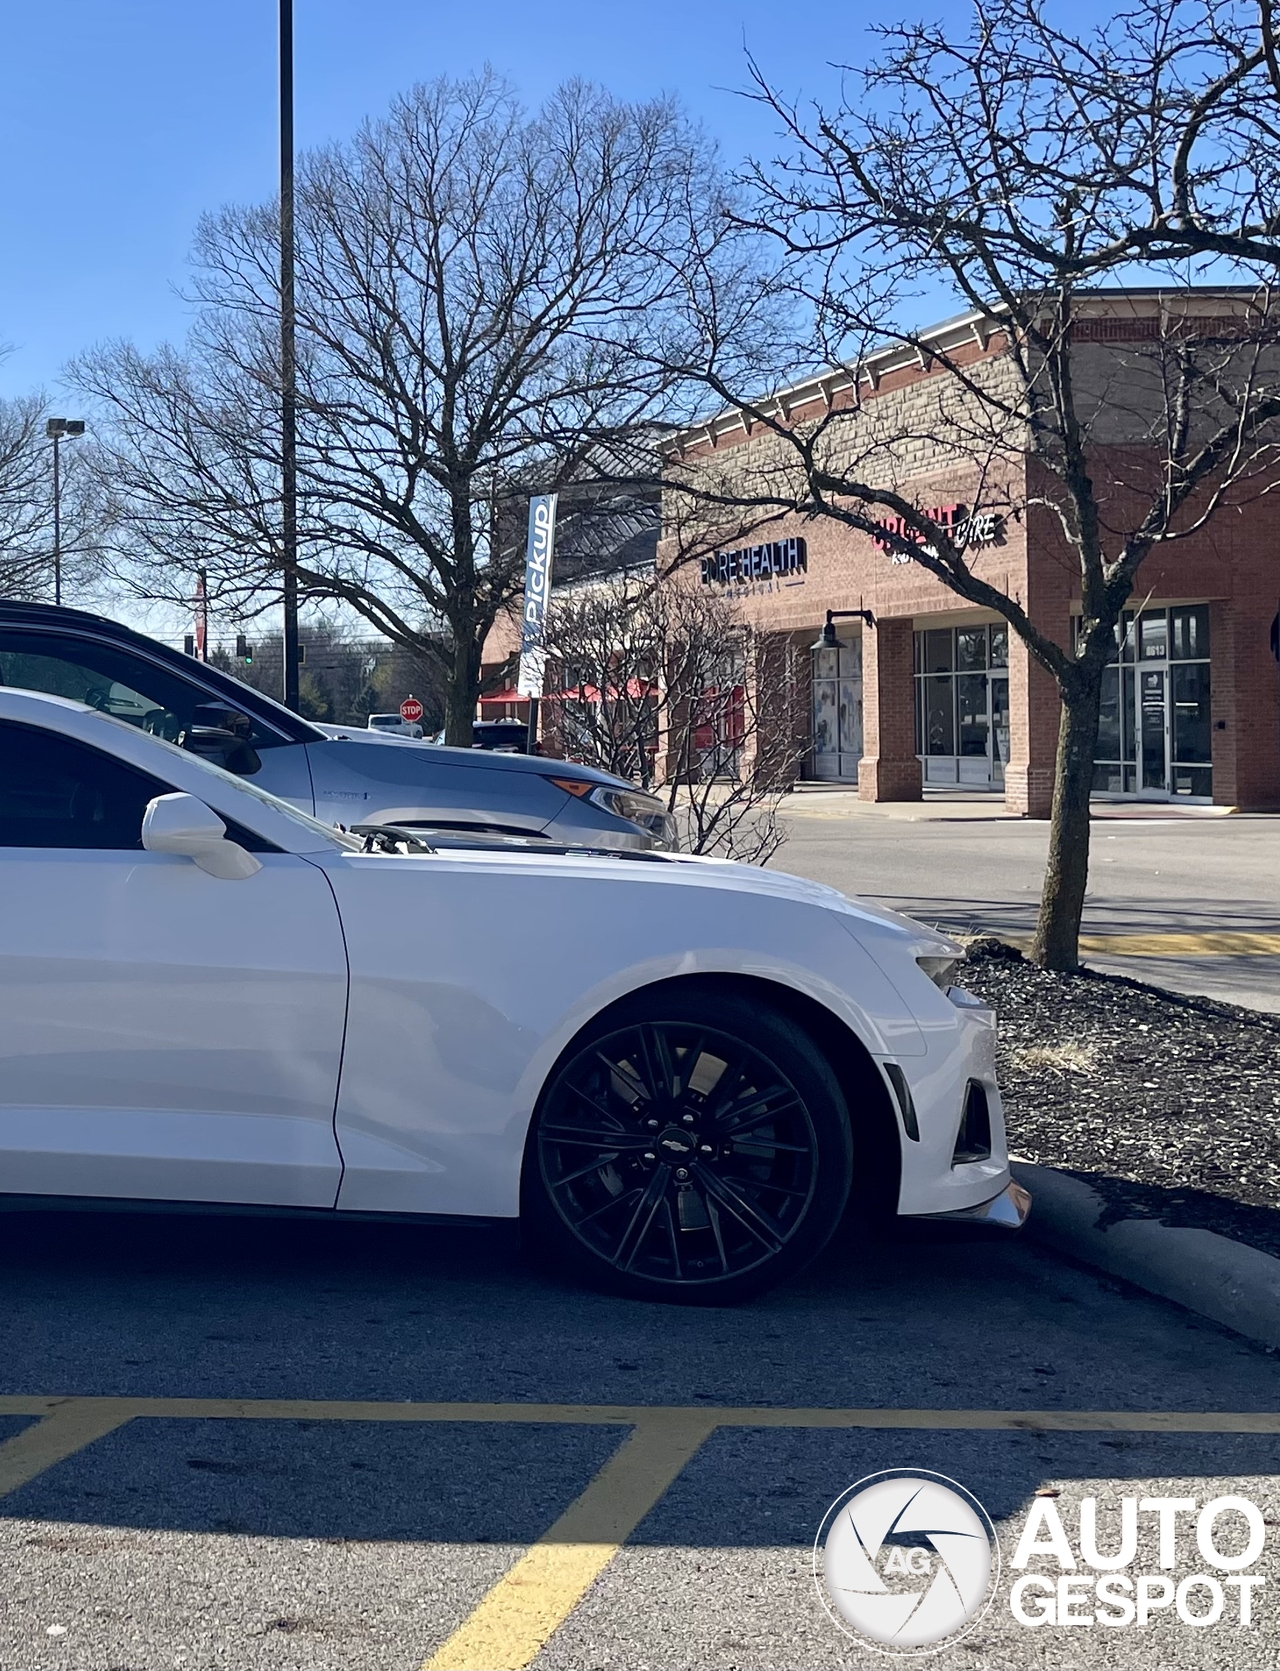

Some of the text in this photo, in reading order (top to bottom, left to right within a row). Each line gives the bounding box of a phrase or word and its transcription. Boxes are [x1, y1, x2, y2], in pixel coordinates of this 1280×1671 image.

[525, 504, 551, 623] Pickup
[741, 538, 798, 577] HEALTH
[402, 705, 421, 716] STOP
